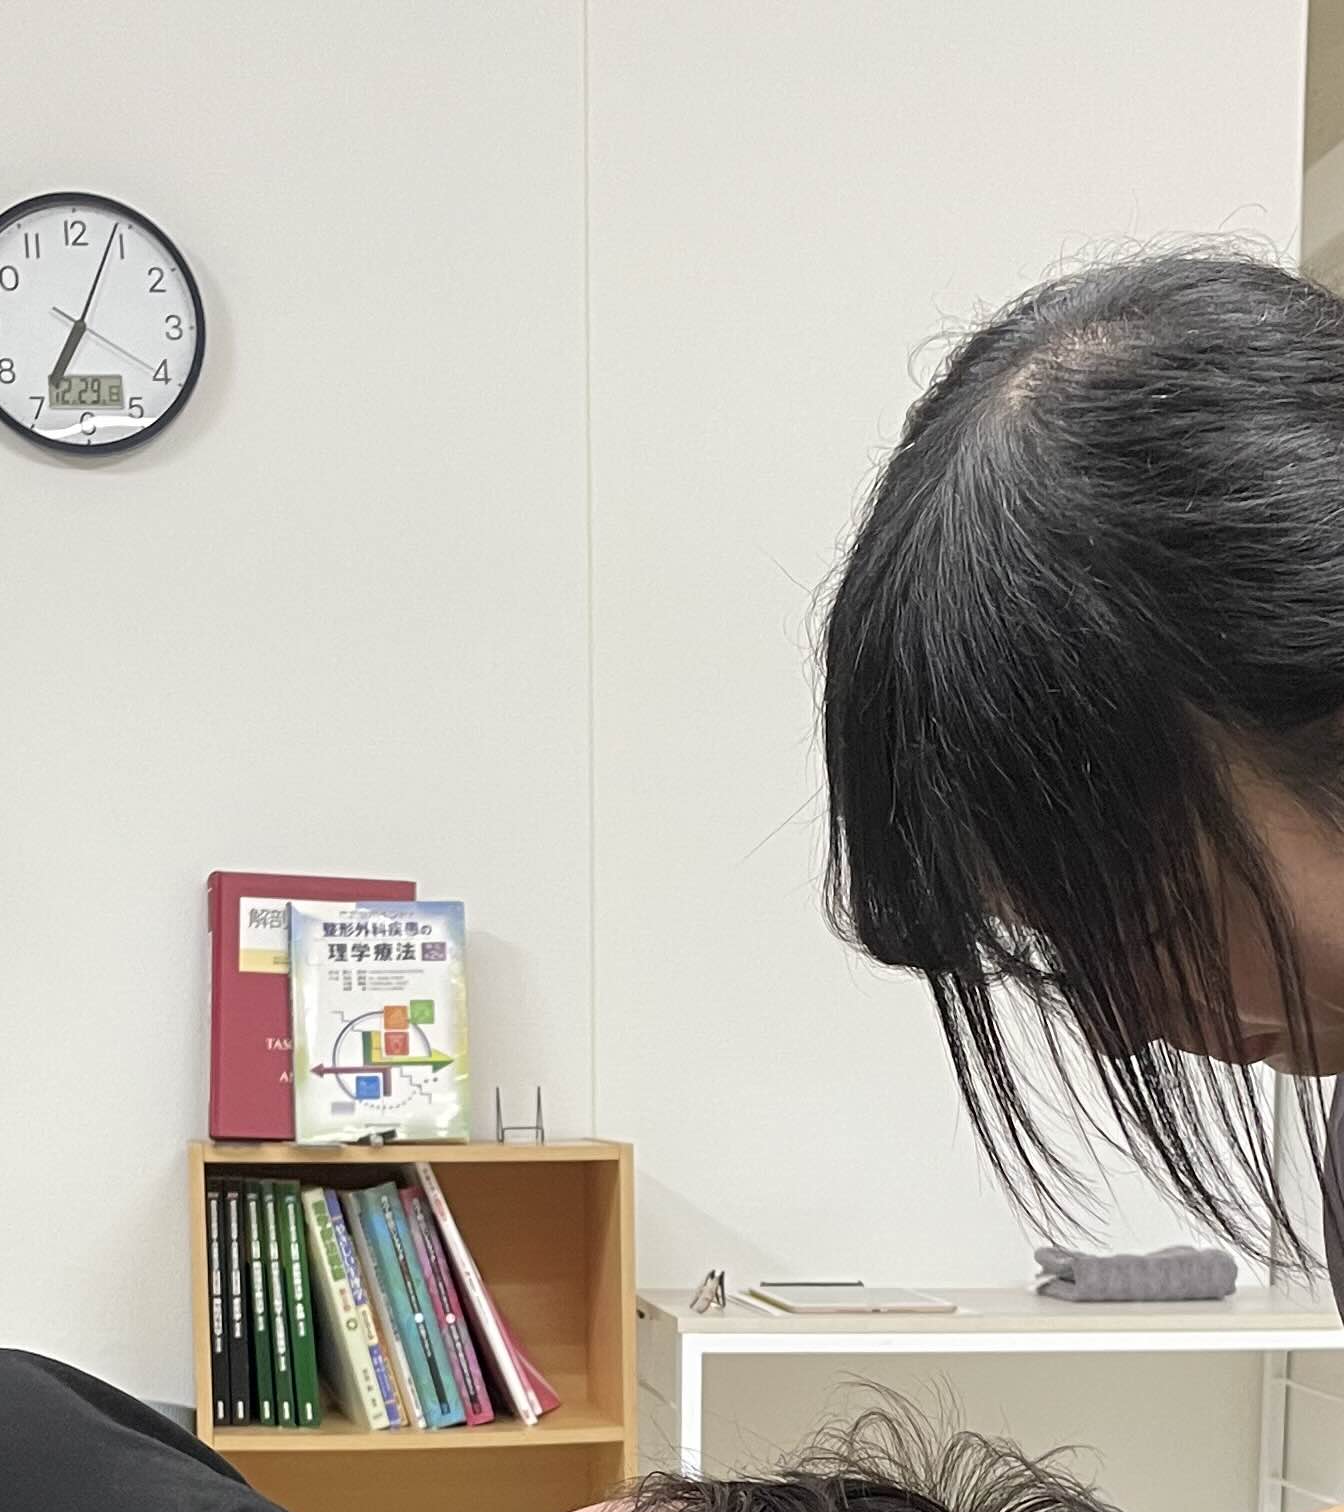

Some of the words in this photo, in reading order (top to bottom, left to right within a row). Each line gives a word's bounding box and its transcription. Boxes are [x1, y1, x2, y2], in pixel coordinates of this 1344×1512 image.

[24, 233, 41, 259] 11
[63, 220, 89, 246] 12
[119, 233, 125, 259] 1
[147, 267, 167, 293] 2
[165, 314, 184, 340] 3
[152, 358, 172, 385] 4
[29, 396, 45, 420] 7
[128, 397, 145, 419] 5
[80, 411, 97, 436] 6
[328, 943, 416, 962] 理学療法
